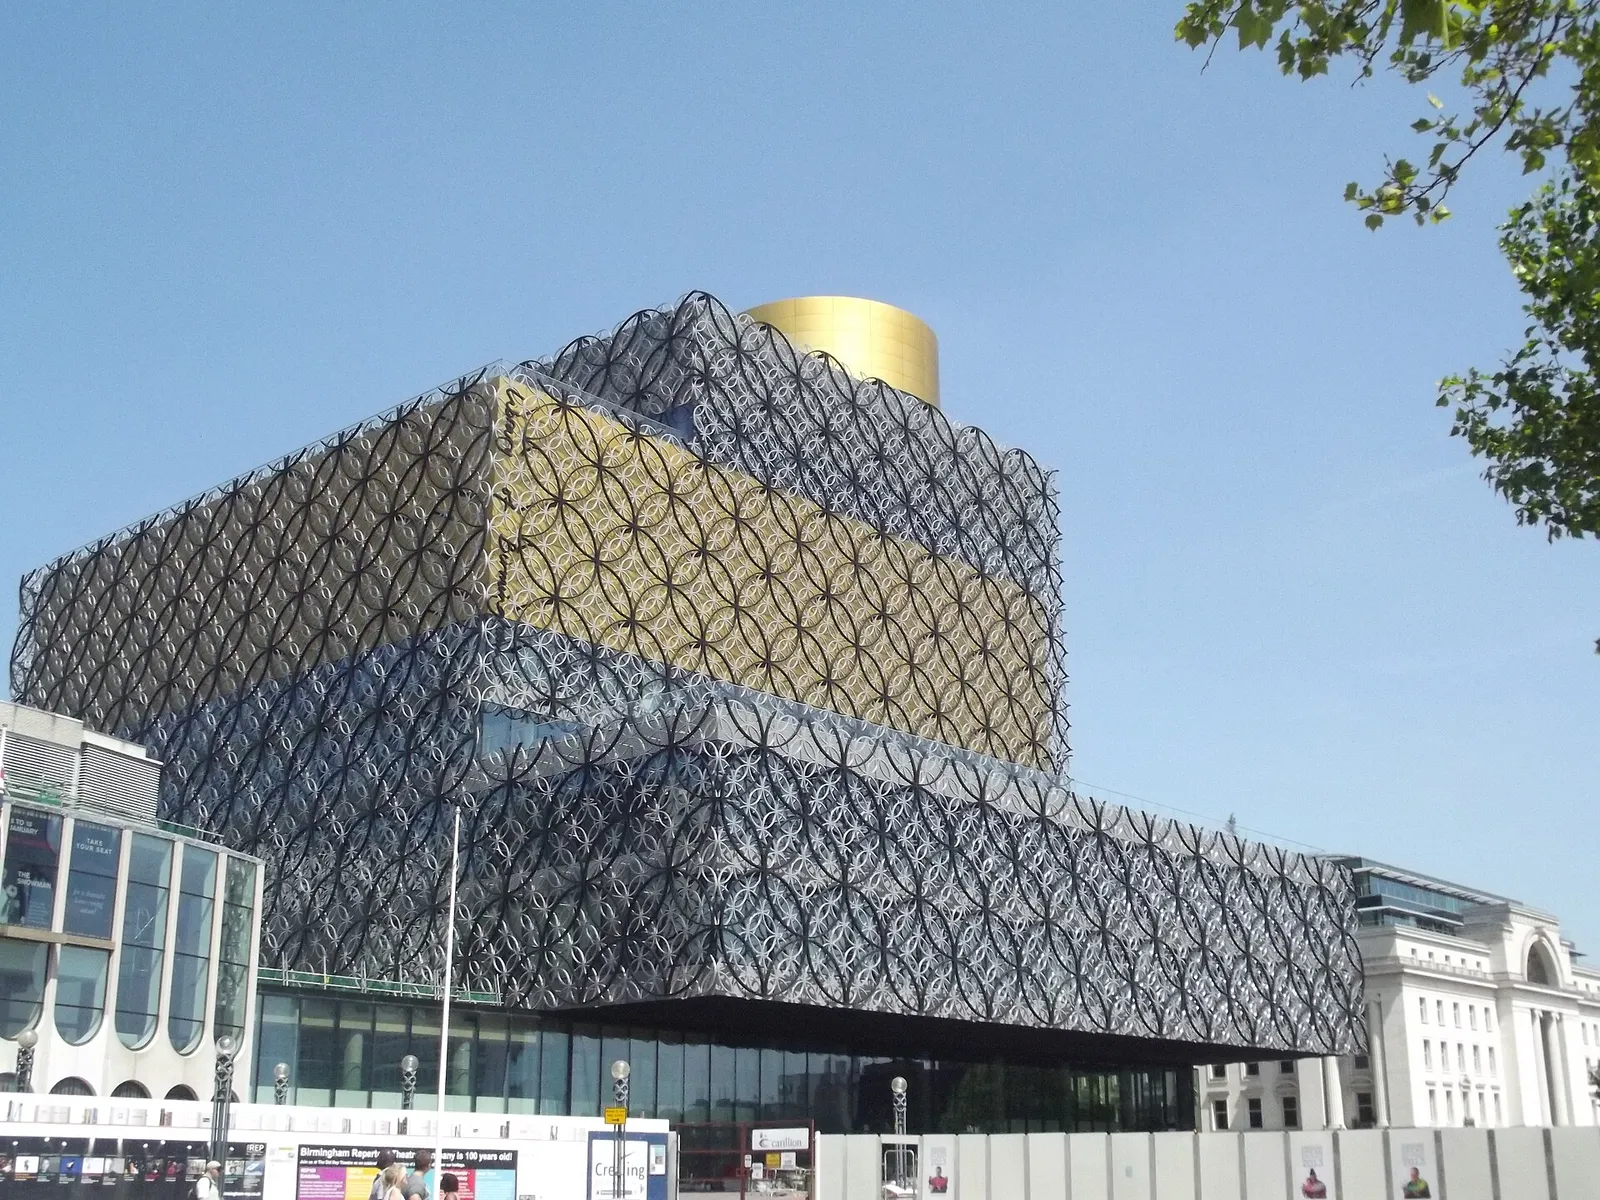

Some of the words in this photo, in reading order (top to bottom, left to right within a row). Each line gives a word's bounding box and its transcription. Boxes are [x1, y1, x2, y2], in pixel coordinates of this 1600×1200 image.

[87, 838, 103, 847] TAKE
[76, 842, 94, 852] YOUR
[95, 846, 113, 855] SEAT
[18, 870, 31, 879] THE
[17, 879, 52, 889] SNOWMAN
[249, 1144, 265, 1152] REP
[300, 1147, 350, 1159] Birmingham
[351, 1148, 380, 1160] Repert
[391, 1149, 416, 1159] Theatr
[464, 1151, 478, 1161] 100
[478, 1153, 498, 1163] years
[498, 1152, 513, 1161] old!
[595, 1161, 645, 1181] Creing
